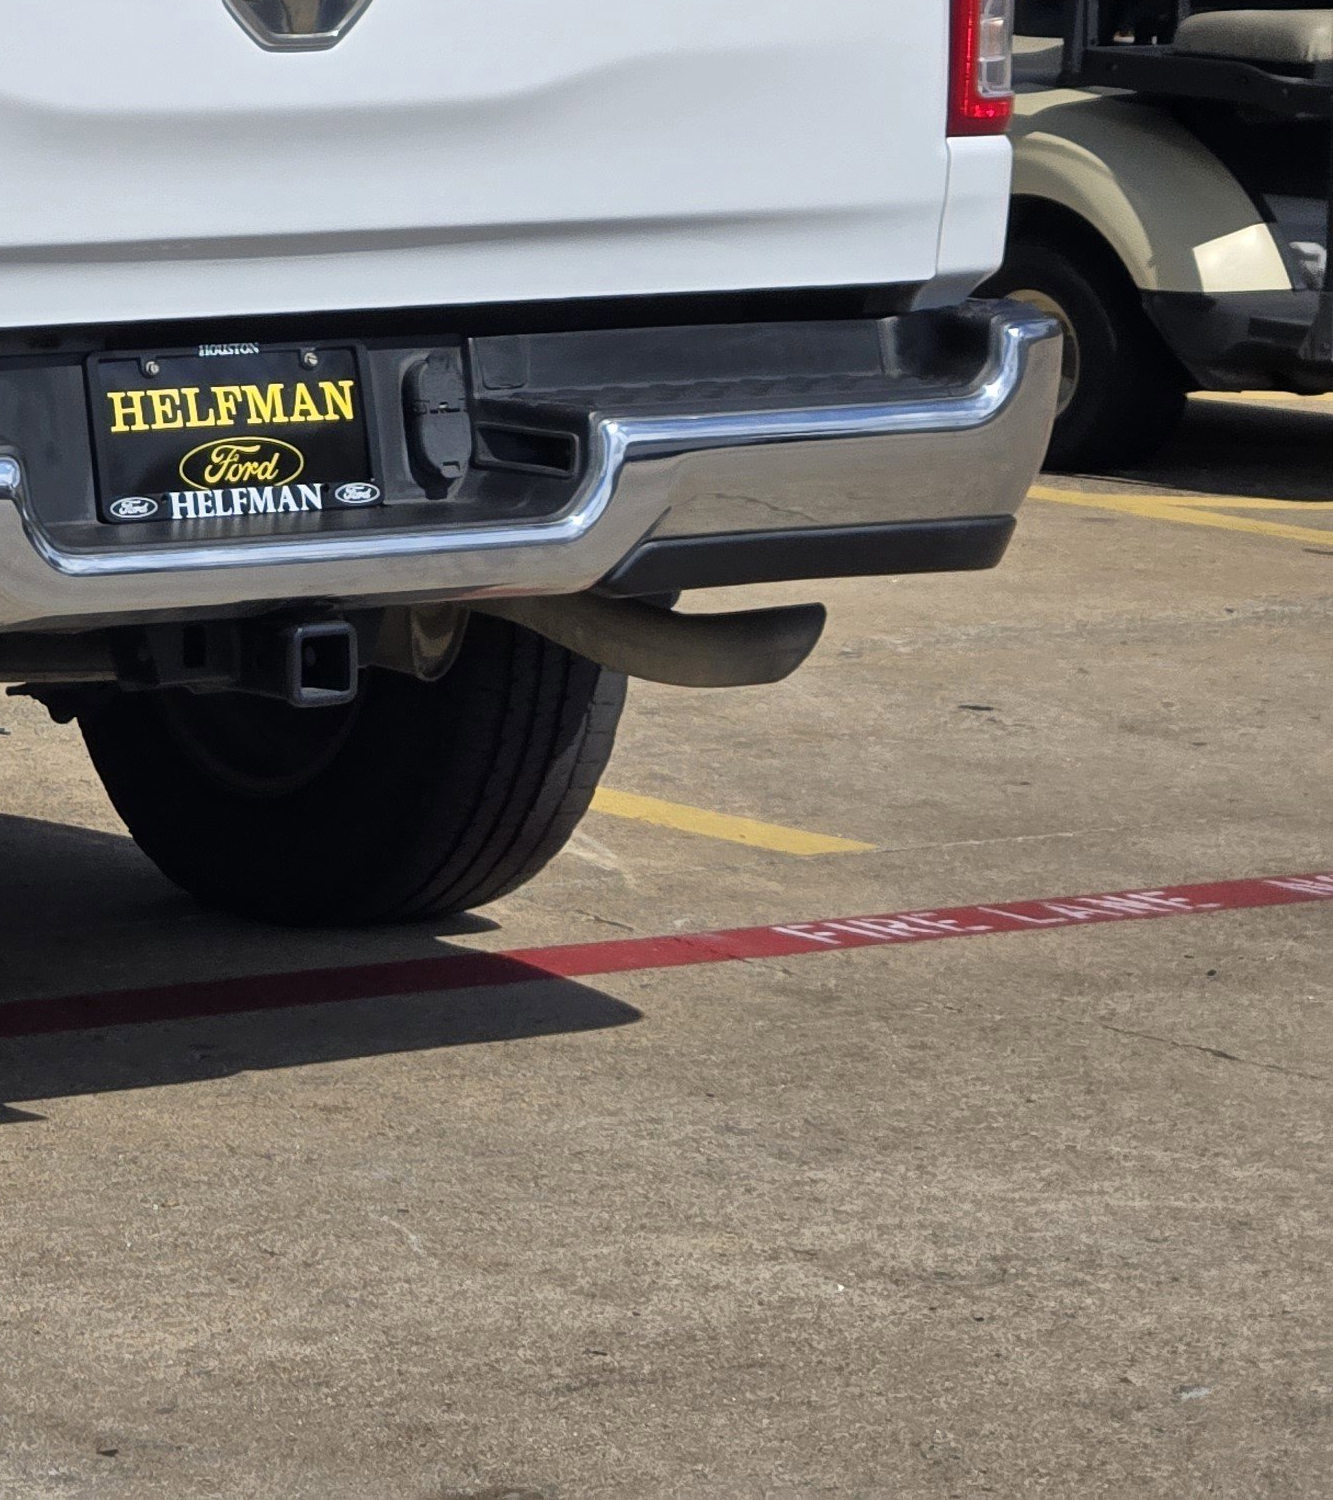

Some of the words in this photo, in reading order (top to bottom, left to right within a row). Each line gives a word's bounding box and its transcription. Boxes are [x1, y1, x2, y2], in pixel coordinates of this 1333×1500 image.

[197, 341, 260, 357] HOUSTON
[106, 380, 354, 433] HELFMAN
[204, 444, 280, 483] Ford
[169, 483, 323, 519] HELFMAN
[769, 911, 994, 945] FIRE
[976, 890, 1222, 923] LANE
